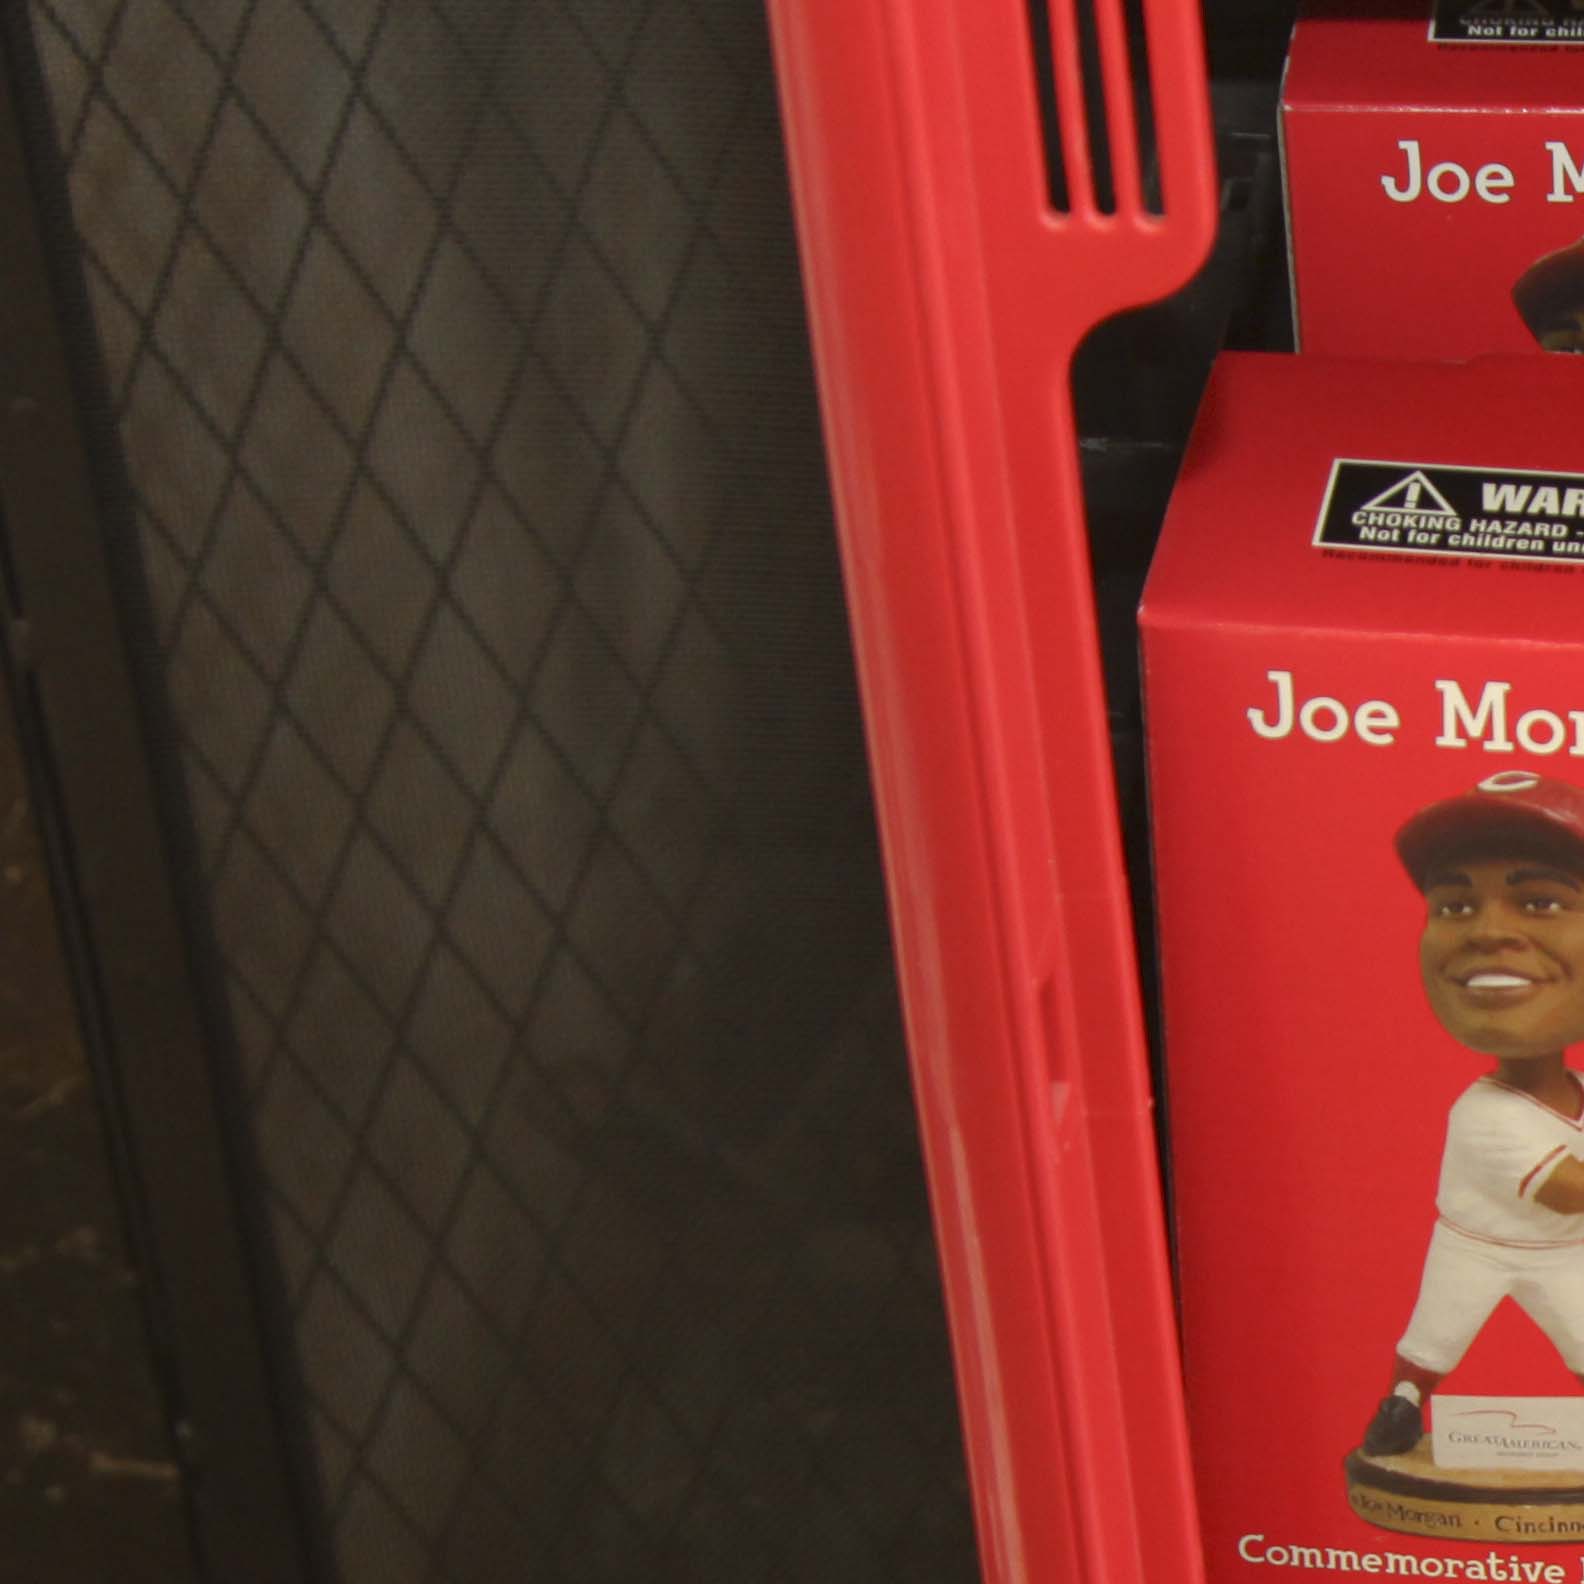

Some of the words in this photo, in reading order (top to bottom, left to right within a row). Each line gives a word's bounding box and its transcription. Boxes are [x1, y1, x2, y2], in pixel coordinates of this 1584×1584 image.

[1467, 25, 1501, 37] Not
[1510, 25, 1538, 37] for
[1381, 139, 1516, 205] Joe
[1351, 510, 1462, 532] CHOKING
[1469, 518, 1568, 539] HAZARD
[1358, 525, 1401, 543] Not
[1406, 527, 1440, 545] for
[1448, 529, 1547, 552] children
[1247, 670, 1400, 745] Joe
